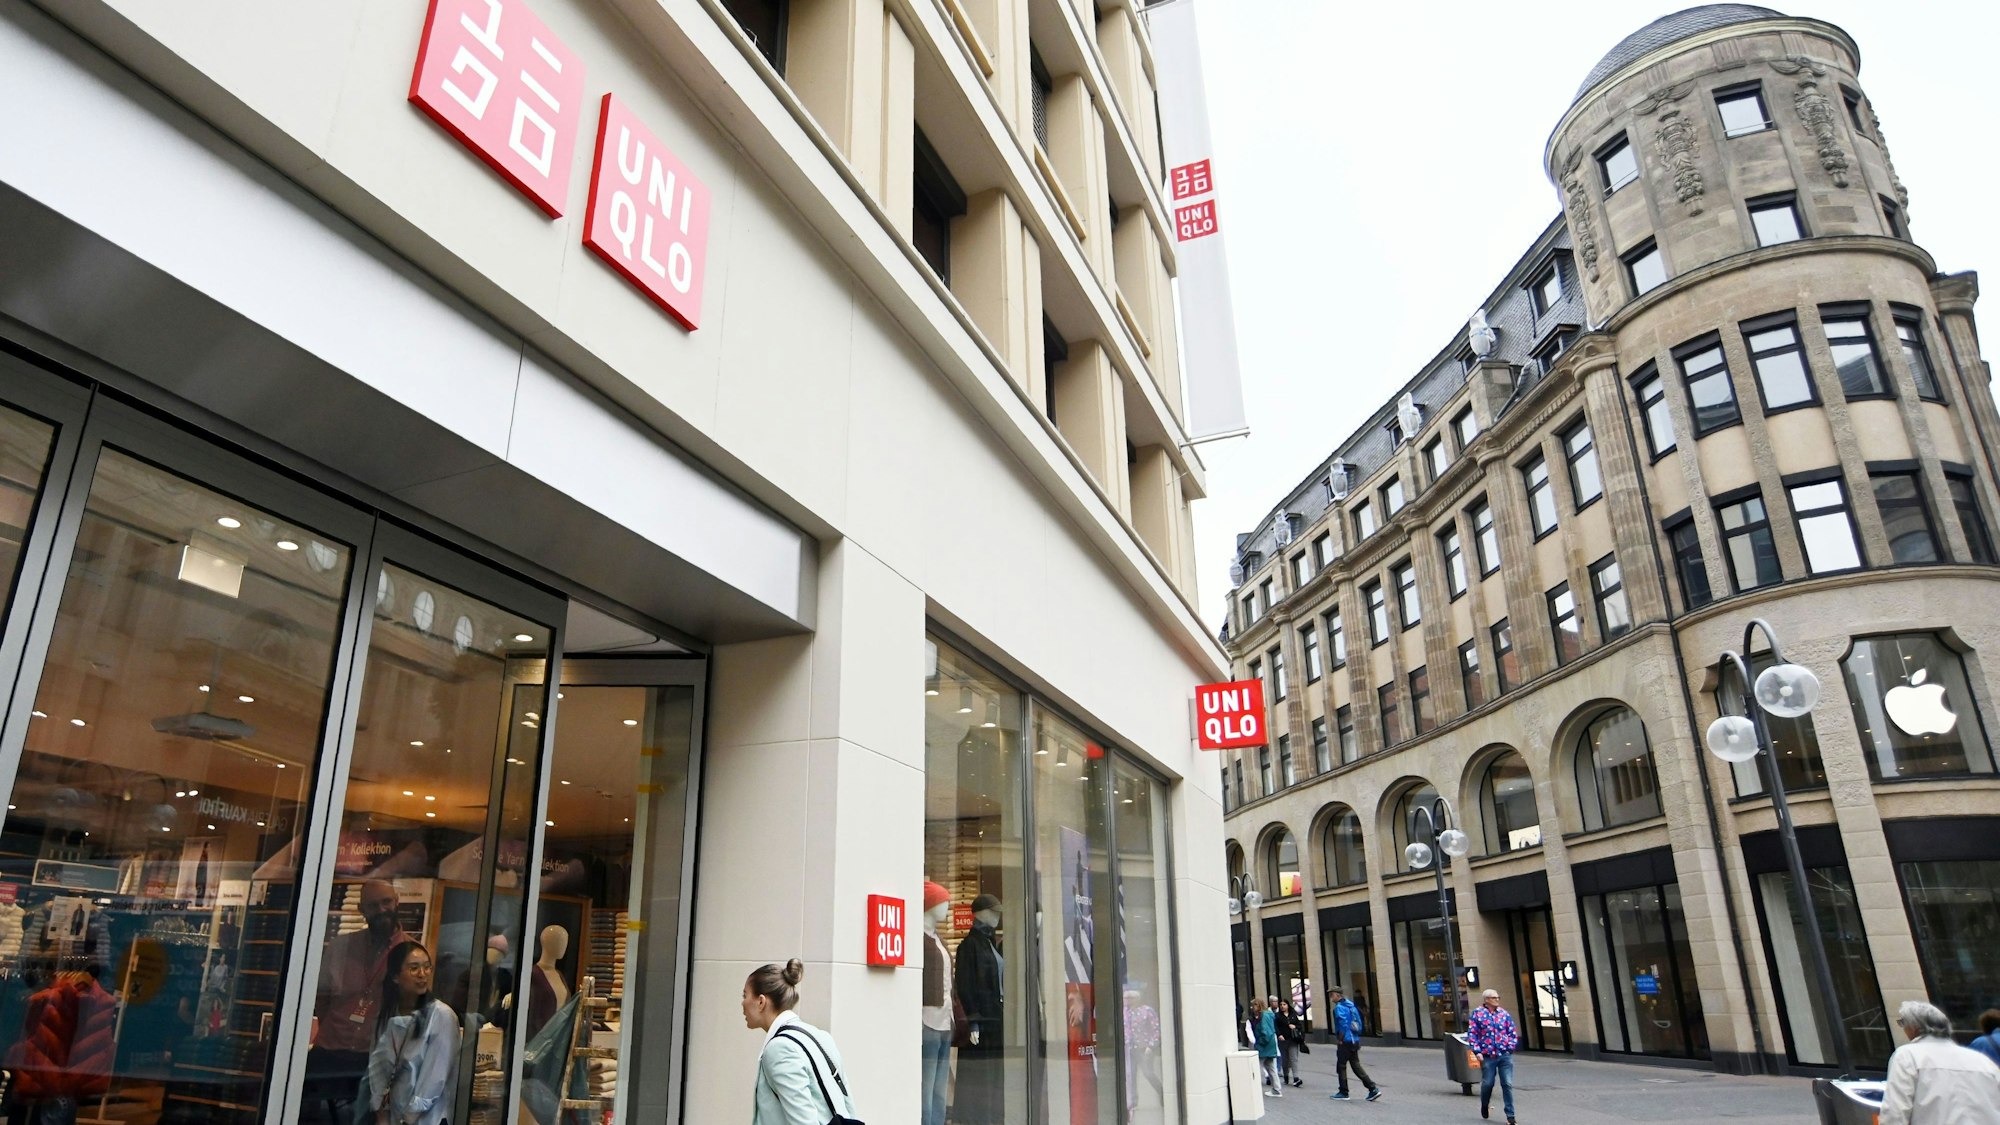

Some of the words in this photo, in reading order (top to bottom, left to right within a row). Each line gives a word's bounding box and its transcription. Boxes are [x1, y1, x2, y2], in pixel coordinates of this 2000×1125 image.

[617, 125, 692, 236] UNI
[1179, 204, 1209, 223] UNI
[1181, 218, 1213, 238] QLO
[609, 190, 693, 294] QLO
[1203, 688, 1251, 714] UNI
[1205, 714, 1257, 744] QLO
[351, 842, 391, 856] Kollektion
[878, 903, 901, 930] UNI
[877, 932, 902, 961] QLO
